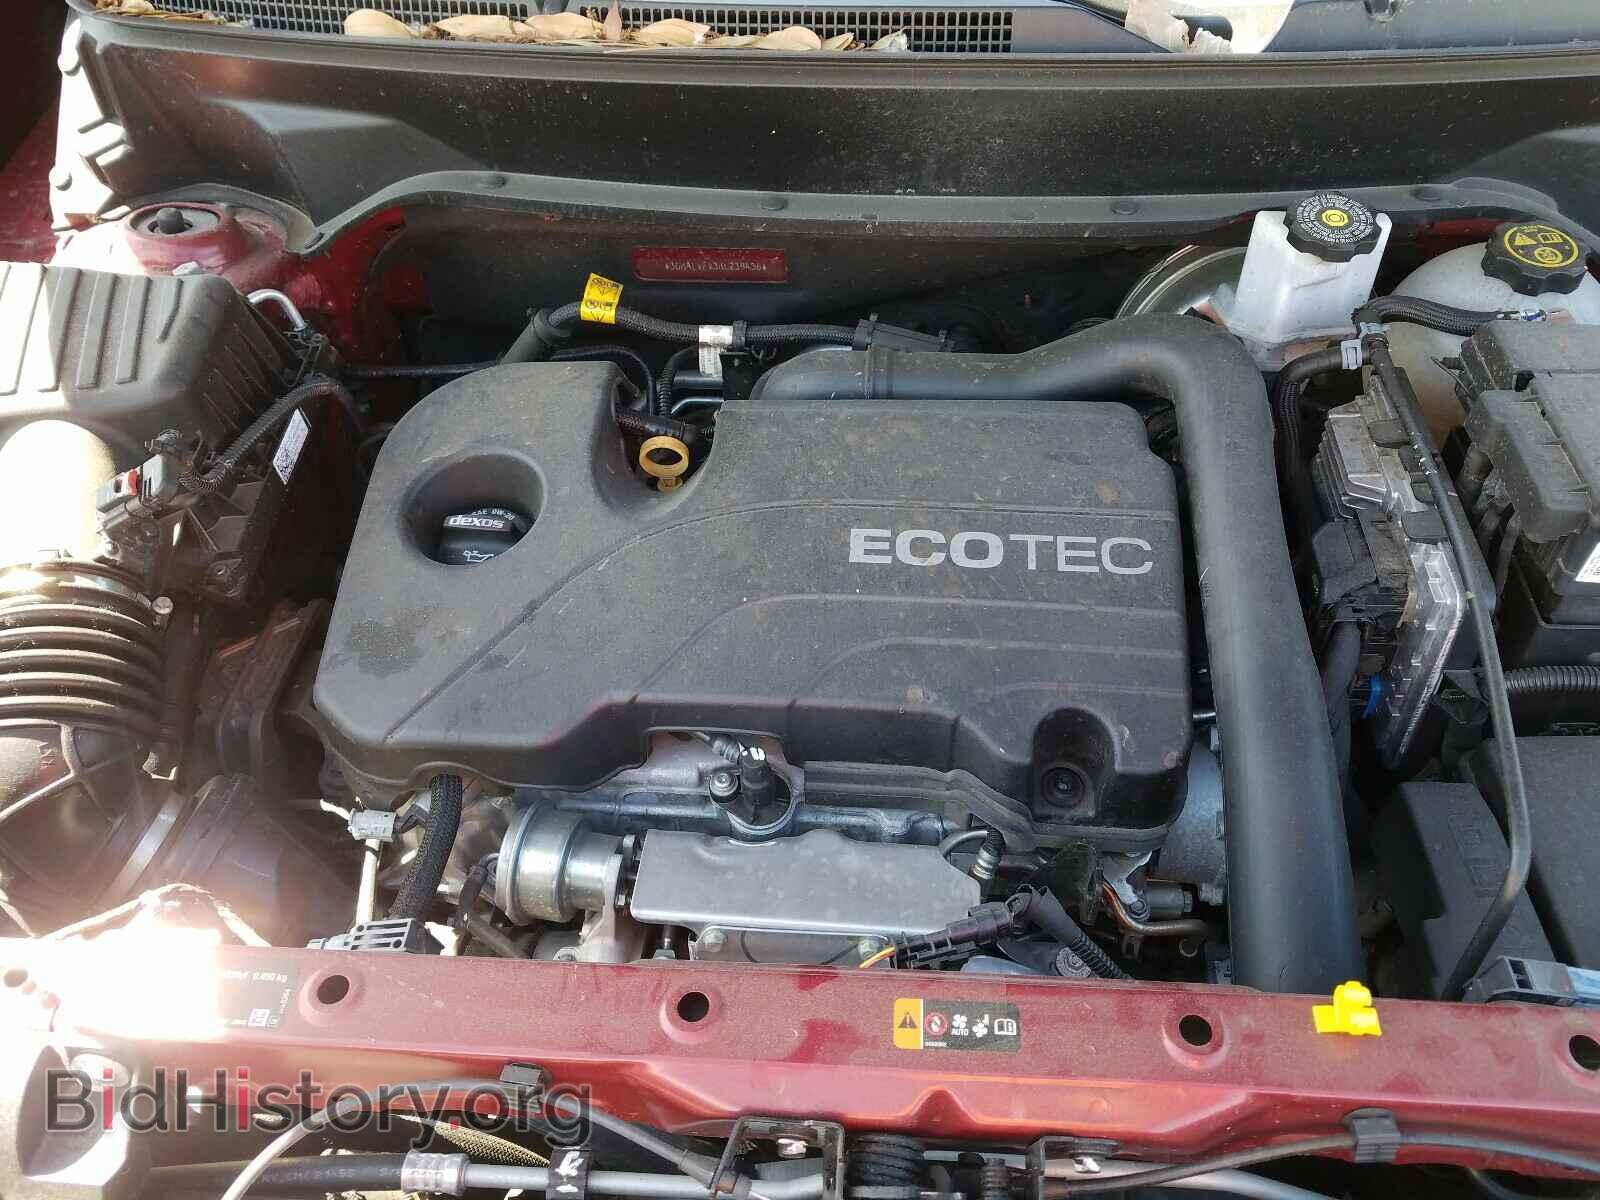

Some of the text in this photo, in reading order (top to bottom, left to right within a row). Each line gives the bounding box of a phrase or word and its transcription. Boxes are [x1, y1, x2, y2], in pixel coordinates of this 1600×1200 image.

[448, 515, 505, 529] dexos
[849, 528, 1153, 574] ECOTEC
[951, 1028, 969, 1036] AUTO
